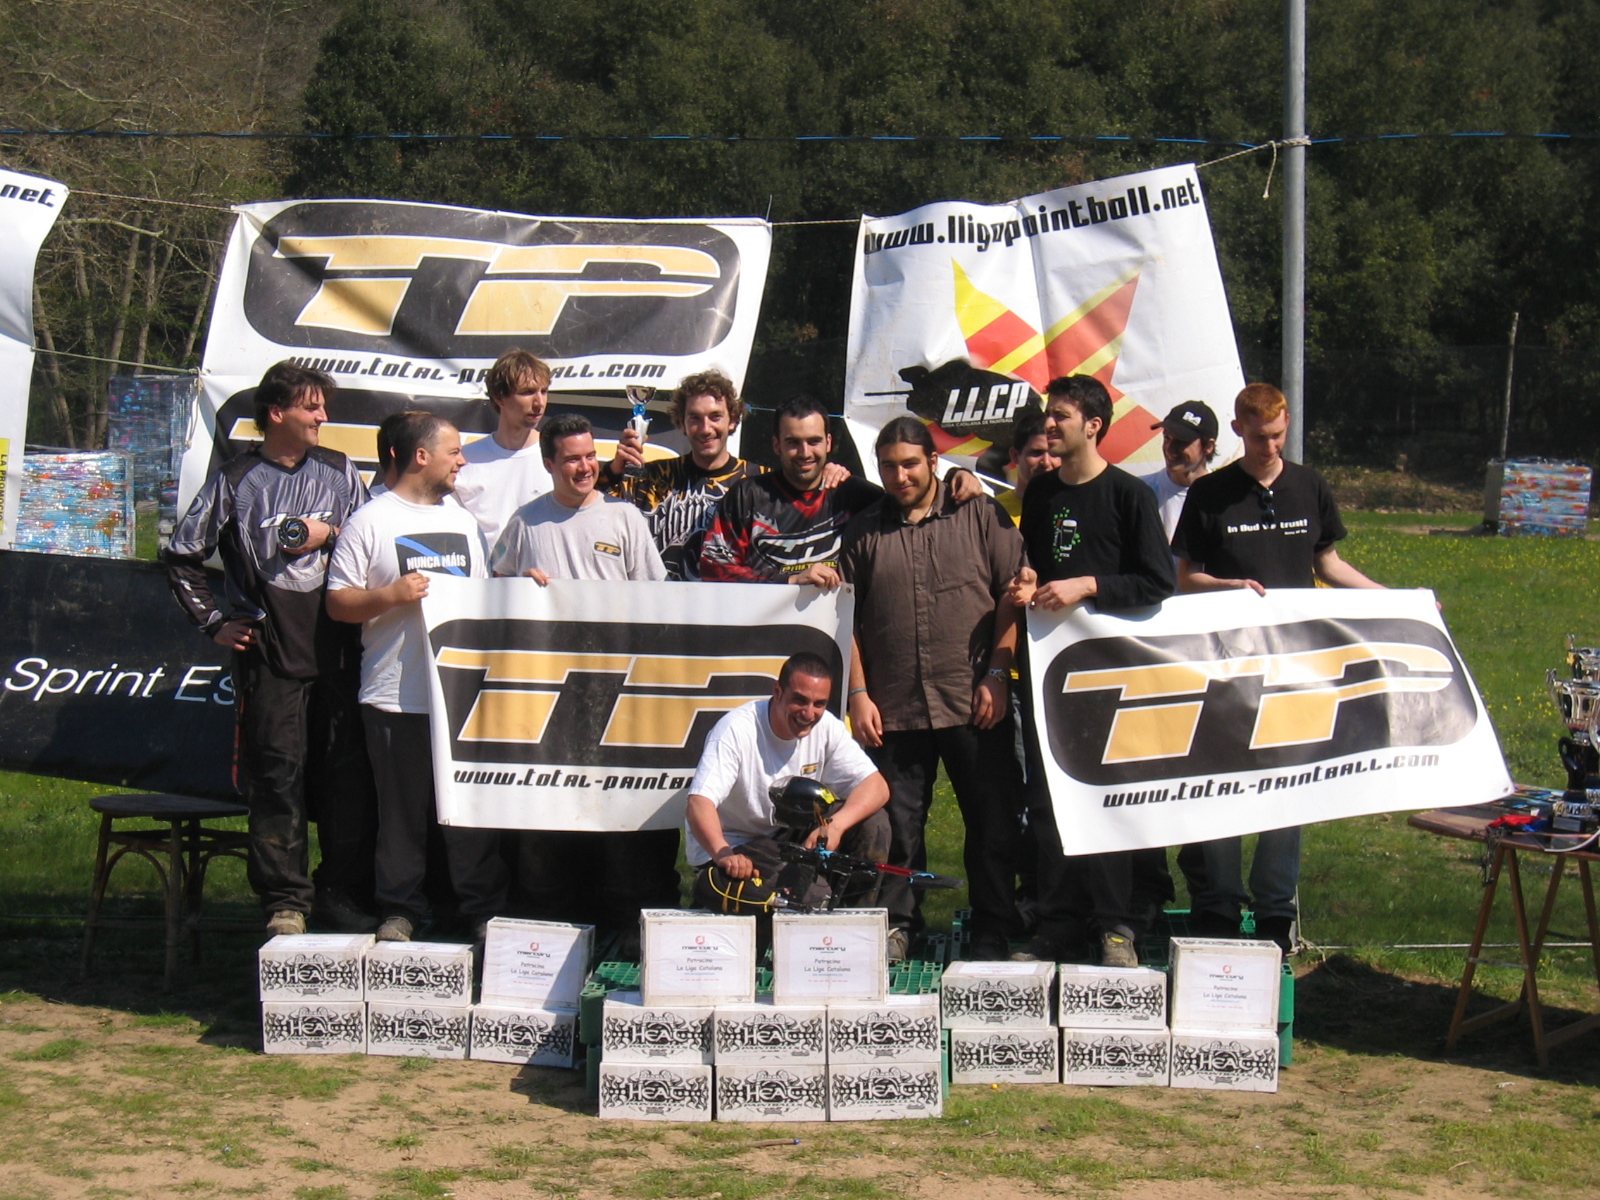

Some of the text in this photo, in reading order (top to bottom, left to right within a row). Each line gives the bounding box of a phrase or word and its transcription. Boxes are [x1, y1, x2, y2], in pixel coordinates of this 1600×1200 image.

[941, 381, 1031, 423] LLCP
[1227, 525, 1238, 533] In
[1240, 523, 1260, 532] Bud
[1279, 519, 1308, 529] trust!
[406, 552, 467, 571] NUNCA MÁIS
[4, 657, 165, 702] Sprint
